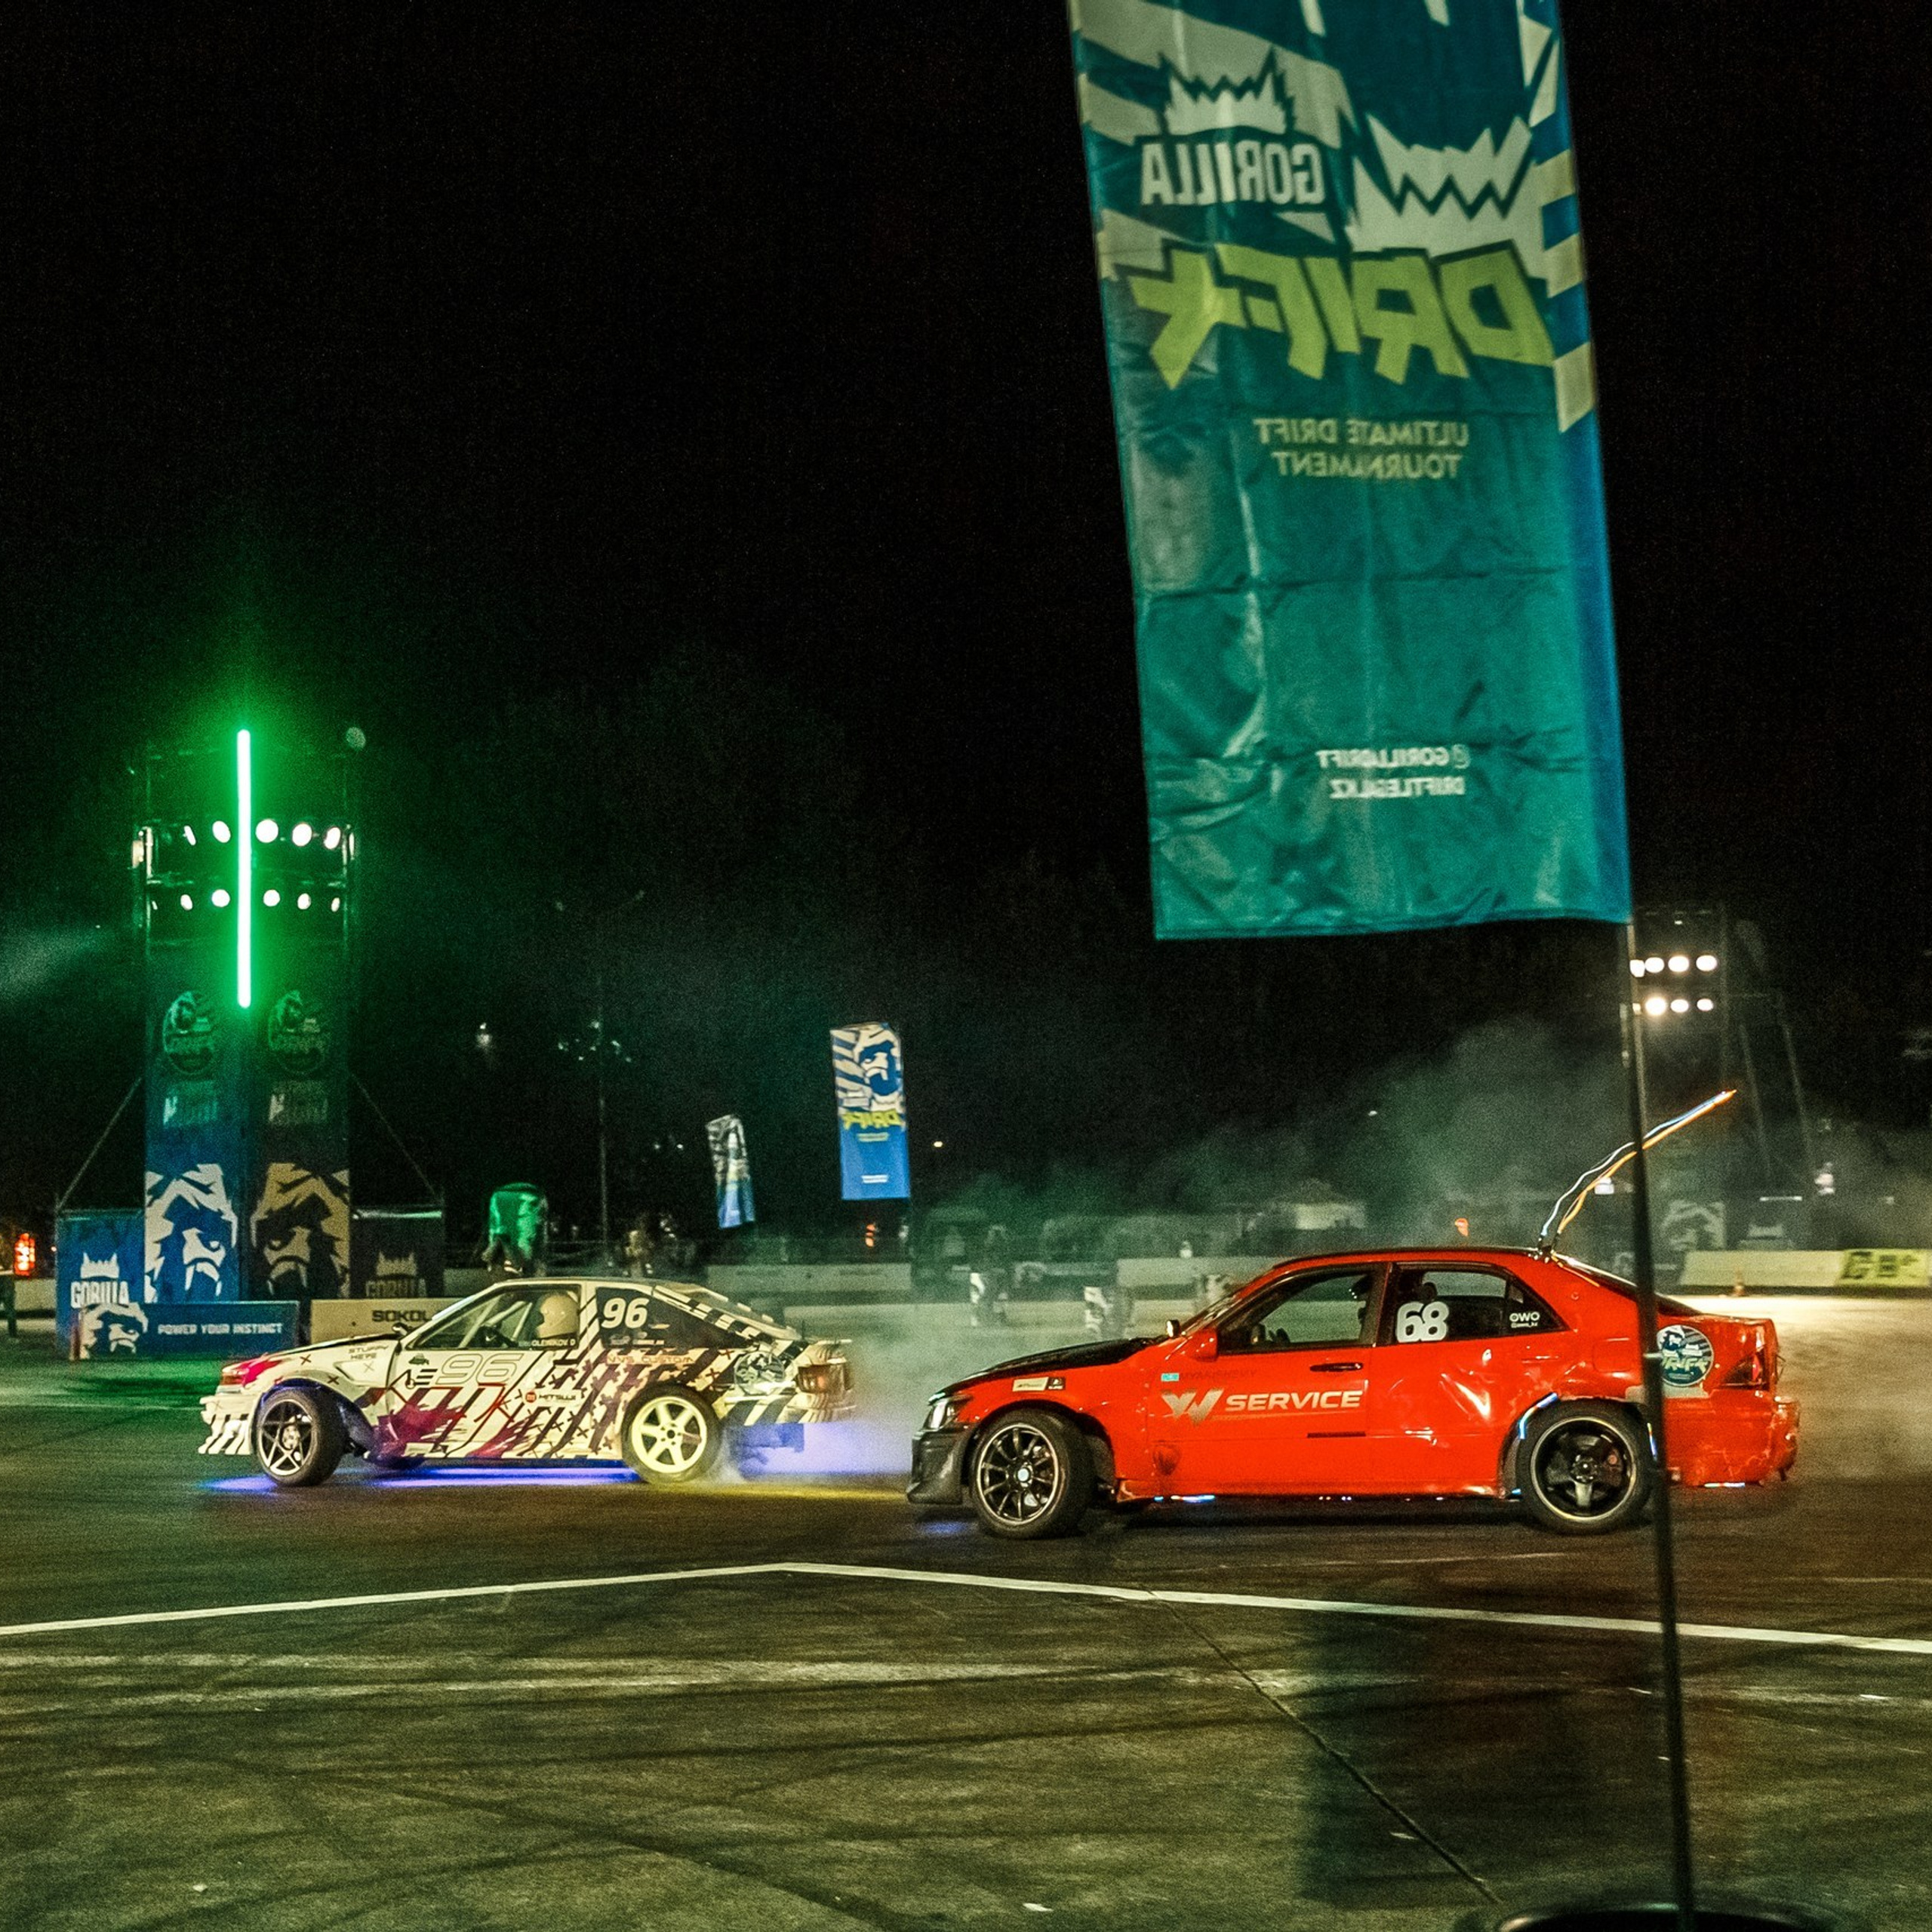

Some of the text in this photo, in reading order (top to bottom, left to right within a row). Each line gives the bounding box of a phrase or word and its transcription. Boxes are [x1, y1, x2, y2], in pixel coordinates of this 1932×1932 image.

[70, 1281, 130, 1309] GORILLA
[371, 1309, 431, 1322] SOKOL
[601, 1297, 650, 1329] 96
[1395, 1300, 1450, 1343] 68
[158, 1322, 282, 1335] POWER YOUR INSTINCT
[435, 1352, 525, 1385] 96
[1225, 1390, 1364, 1412] SERVICE
